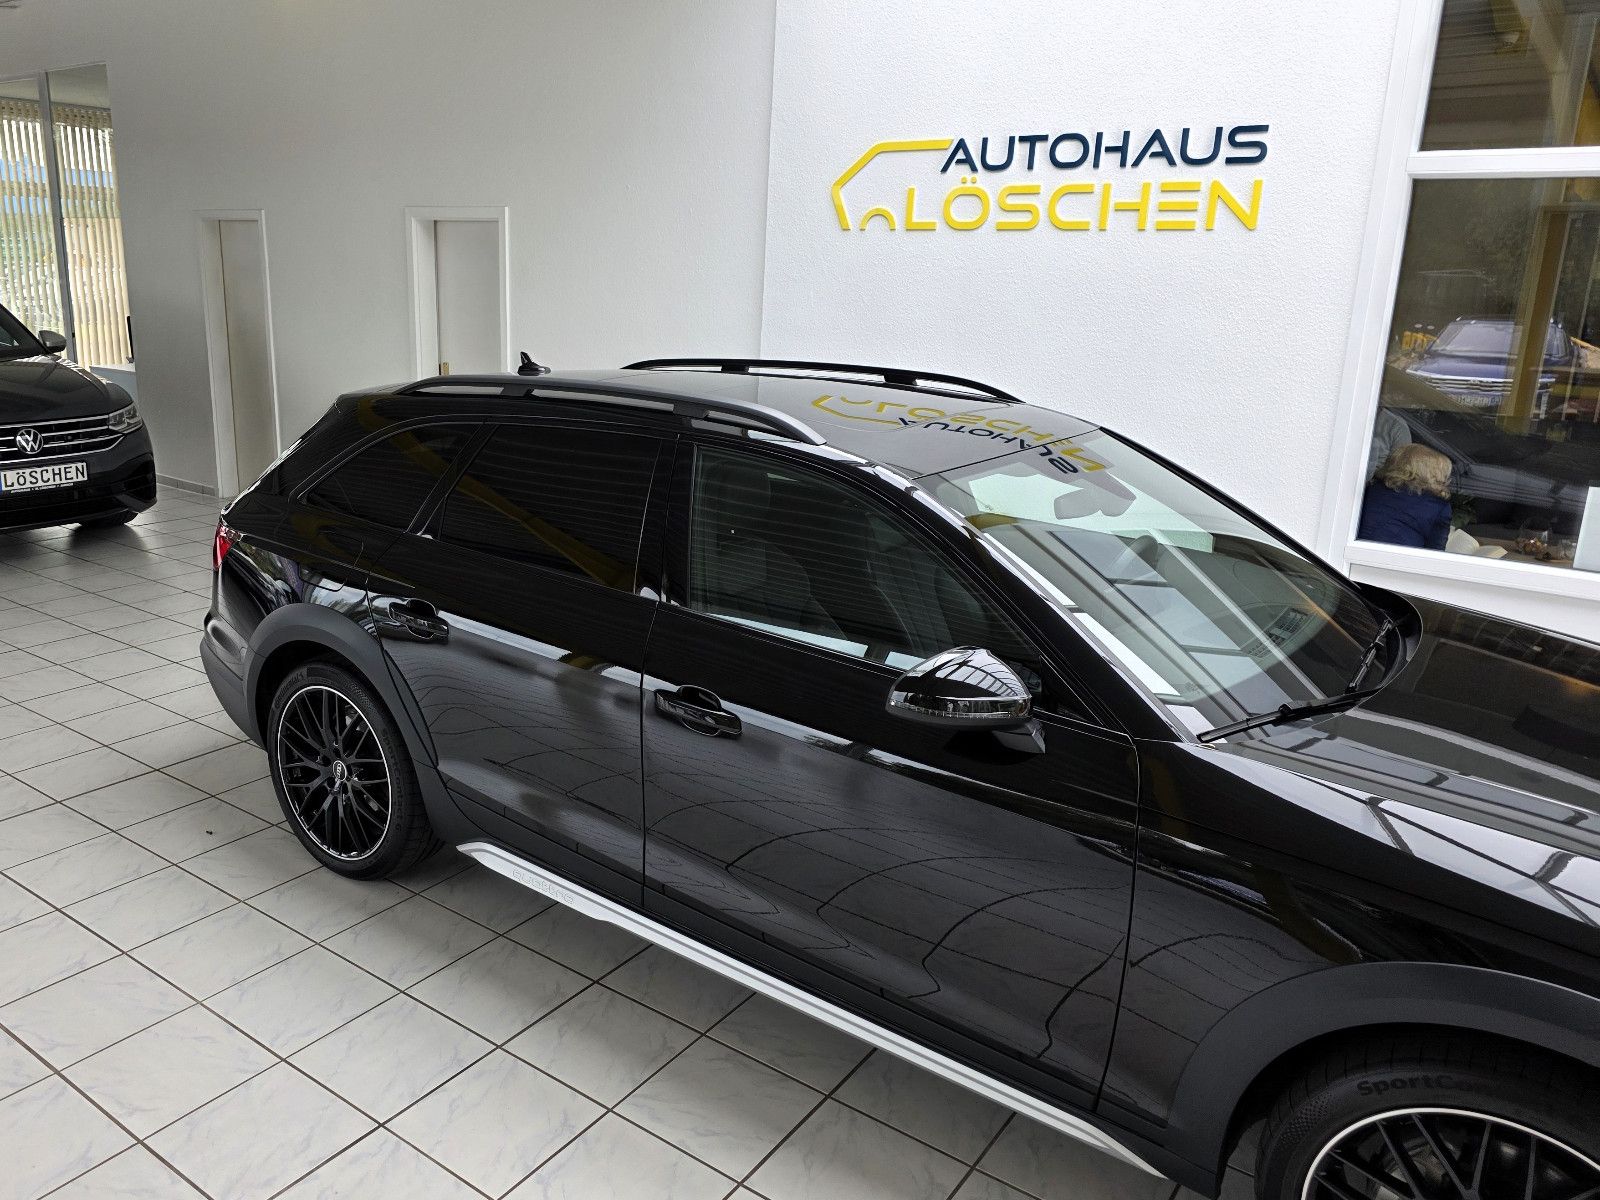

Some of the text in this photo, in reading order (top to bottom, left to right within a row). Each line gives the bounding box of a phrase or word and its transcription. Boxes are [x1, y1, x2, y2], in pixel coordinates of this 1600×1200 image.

[940, 124, 1270, 173] AUTOHAUS
[905, 177, 1264, 231] LÖSCHEN
[4, 464, 85, 488] LÖSCHEN
